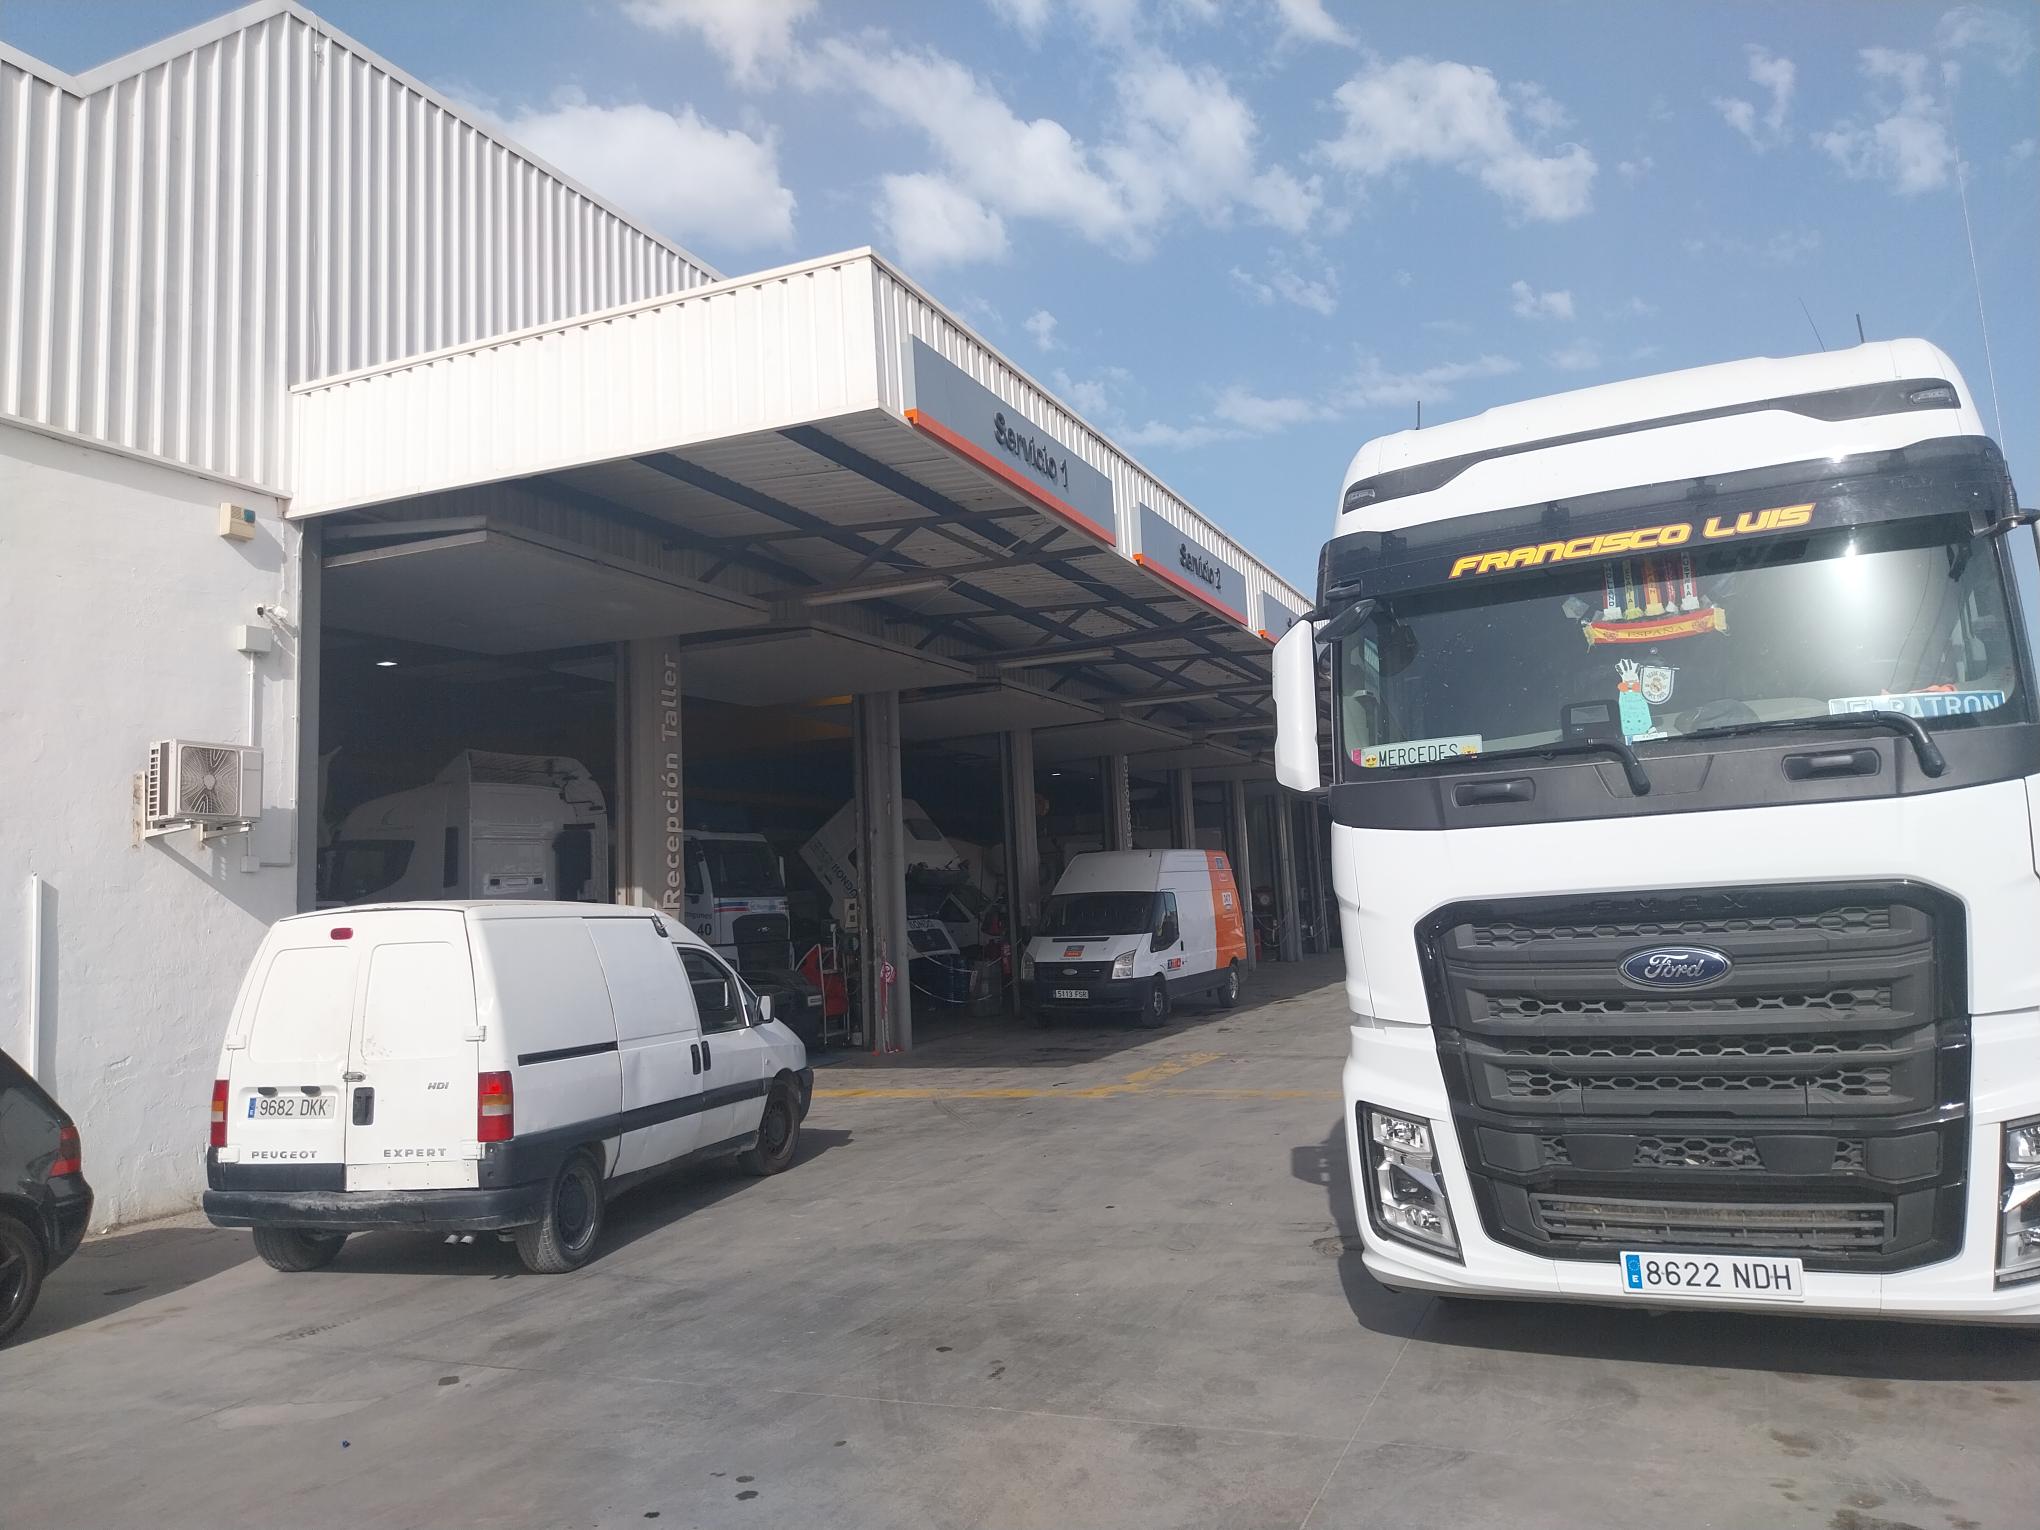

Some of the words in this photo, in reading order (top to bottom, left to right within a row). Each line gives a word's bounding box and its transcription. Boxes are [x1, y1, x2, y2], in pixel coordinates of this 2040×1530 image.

[993, 411, 1058, 480] Servicio
[1061, 458, 1069, 489] 1
[1449, 523, 1692, 579] FRANCISCO
[1703, 502, 1816, 538] LUIS
[1179, 542, 1215, 585] Servicio
[661, 652, 680, 744] Taller
[1379, 743, 1459, 768] MERCEDES
[662, 752, 682, 910] Recepción
[697, 923, 712, 936] 40
[1644, 954, 1705, 979] Ford
[427, 1081, 450, 1091] HDI
[259, 1099, 295, 1116] 9682
[300, 1098, 328, 1116] DKK
[251, 1150, 318, 1160] PEUGEOT
[383, 1148, 447, 1158] EXPERT
[1646, 1260, 1721, 1287] 8622
[1732, 1262, 1792, 1290] NDH
